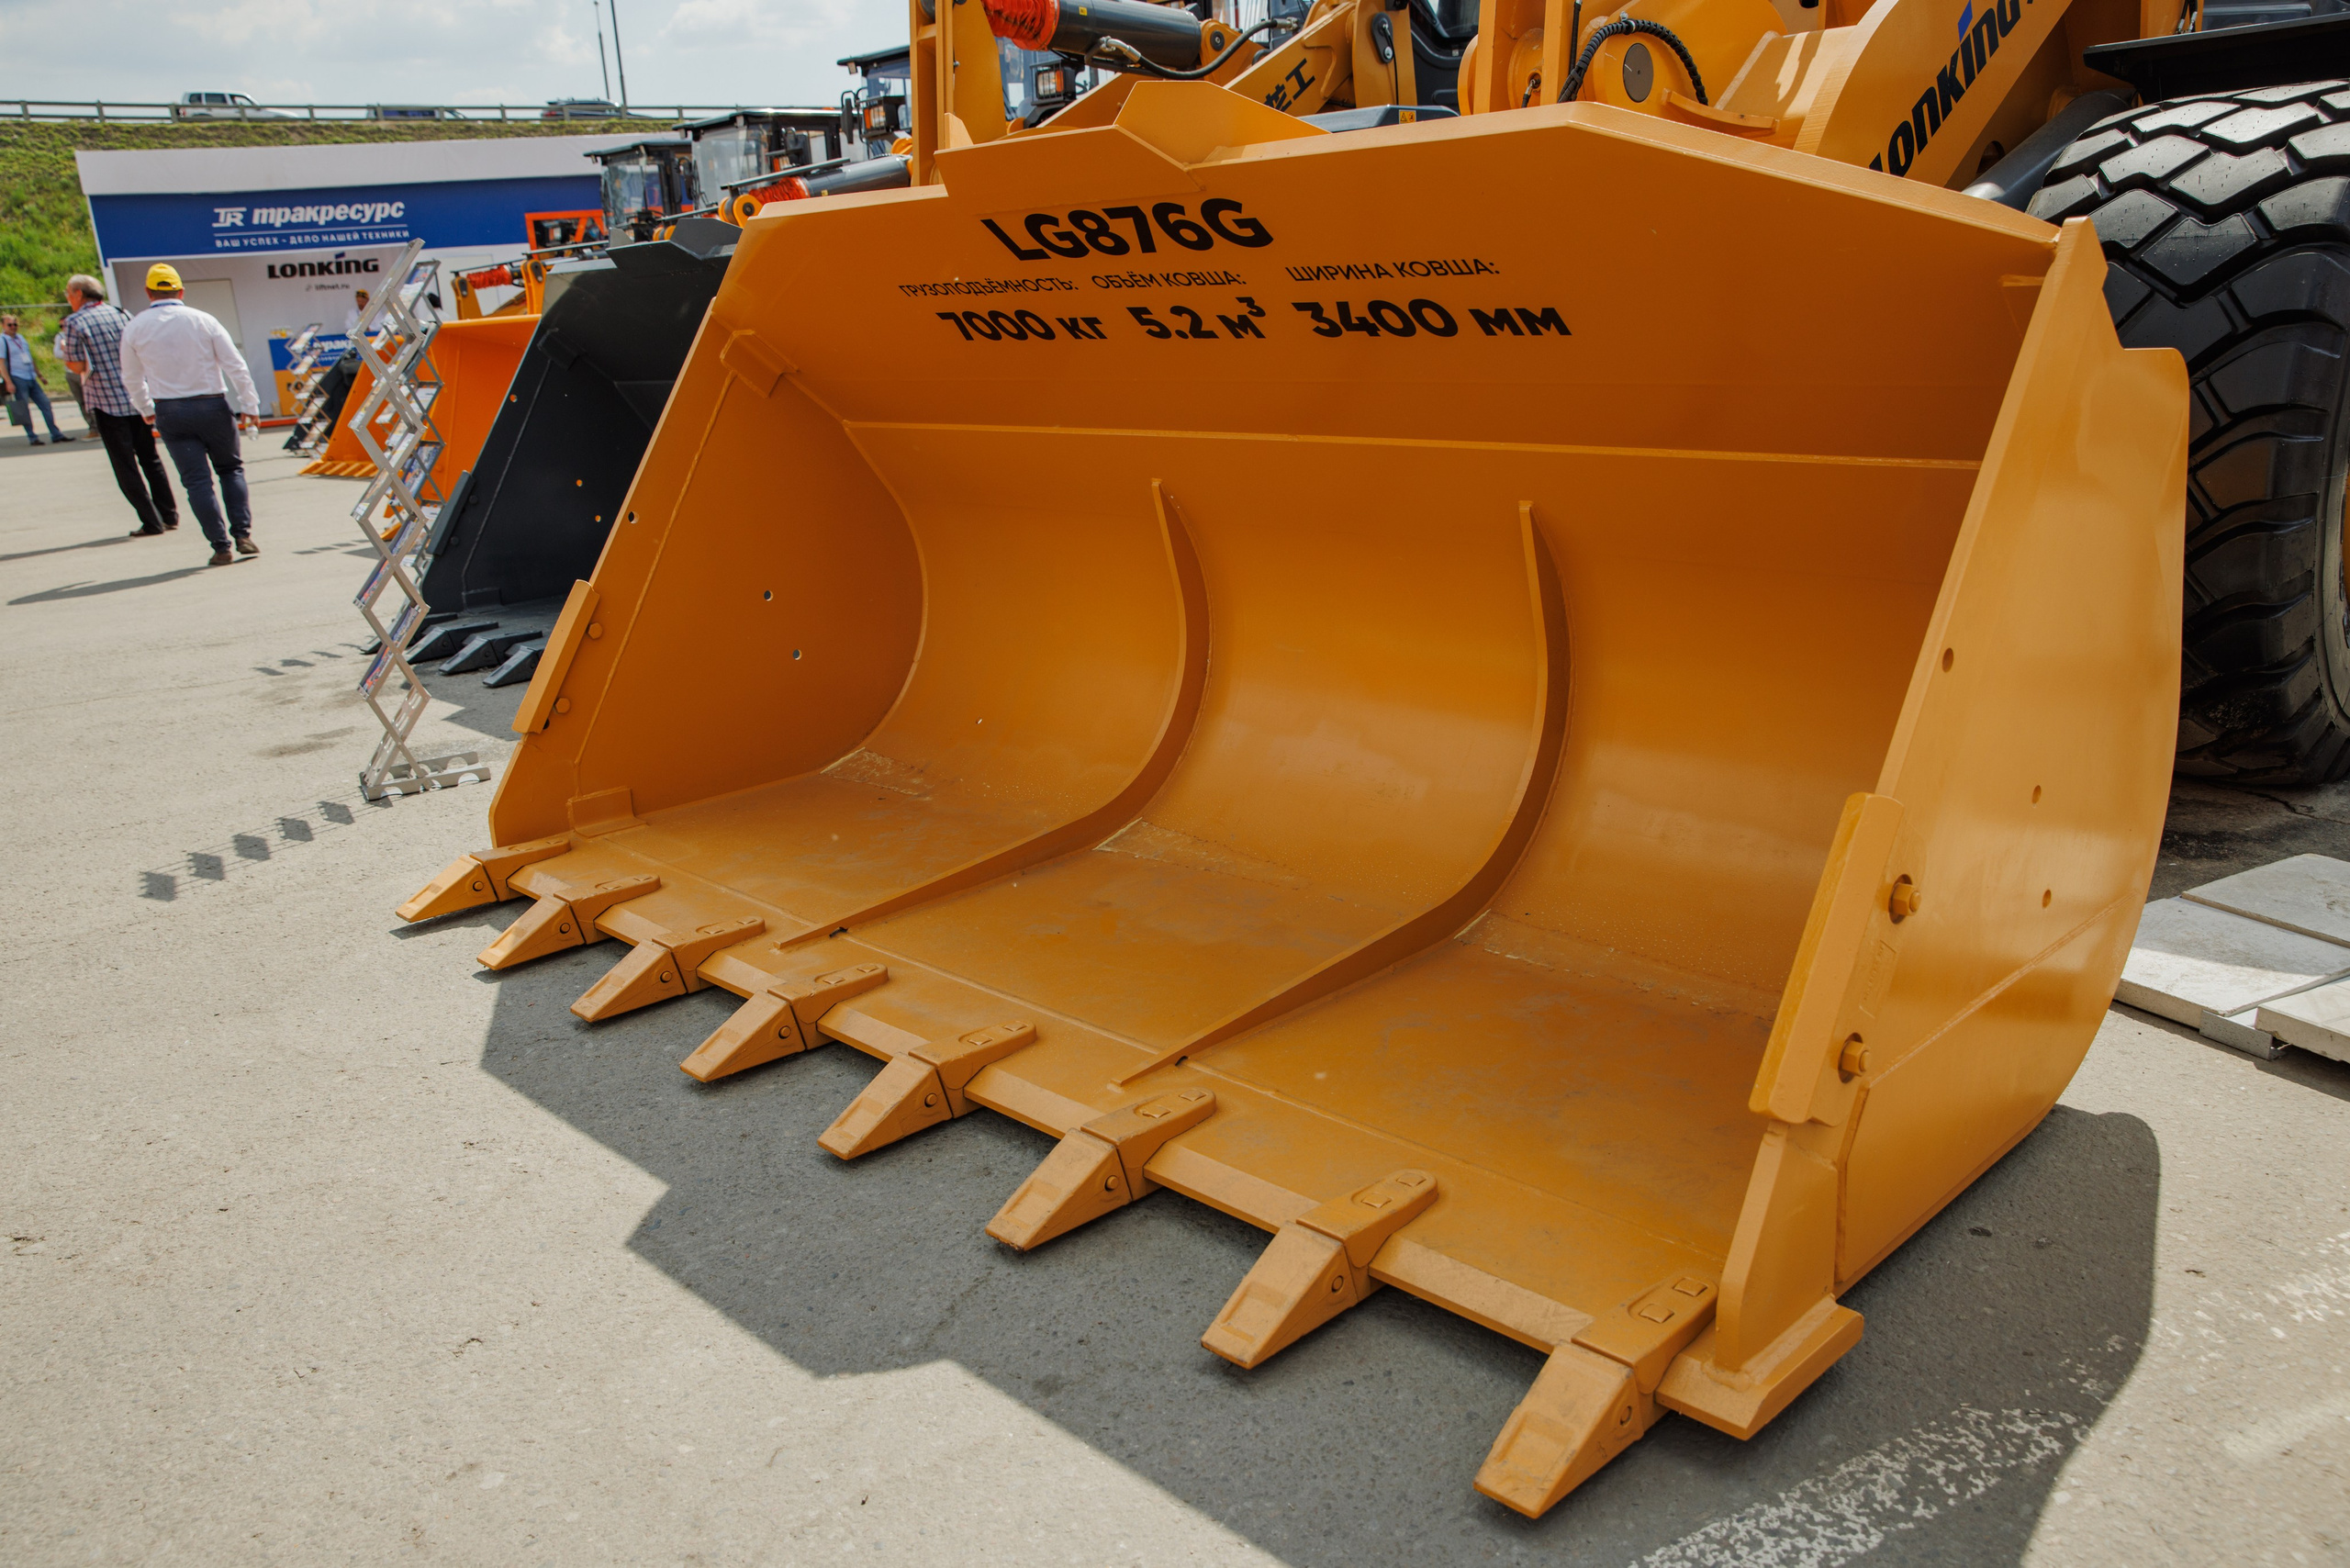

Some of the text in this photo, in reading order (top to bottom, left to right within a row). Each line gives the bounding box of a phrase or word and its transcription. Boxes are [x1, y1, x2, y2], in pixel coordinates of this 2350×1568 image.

[252, 201, 405, 228] тракресурс
[215, 238, 241, 249] ВАШ
[242, 236, 279, 247] УСПЕХ
[289, 234, 319, 246] ДЕЛО
[321, 230, 360, 242] НАШЕЙ
[362, 230, 409, 241] ТЕХНИКИ
[980, 197, 1274, 261] LG876G
[1091, 270, 1248, 289] ОБЪЁМ КОВША:
[1285, 258, 1500, 281] ШИРИНА КОВША:
[898, 277, 1080, 297] ГРУЗОПОДЪЁМНОСТЬ:
[934, 309, 1056, 341] 7000
[1125, 306, 1220, 339] 5.2
[1291, 298, 1459, 338] 3400
